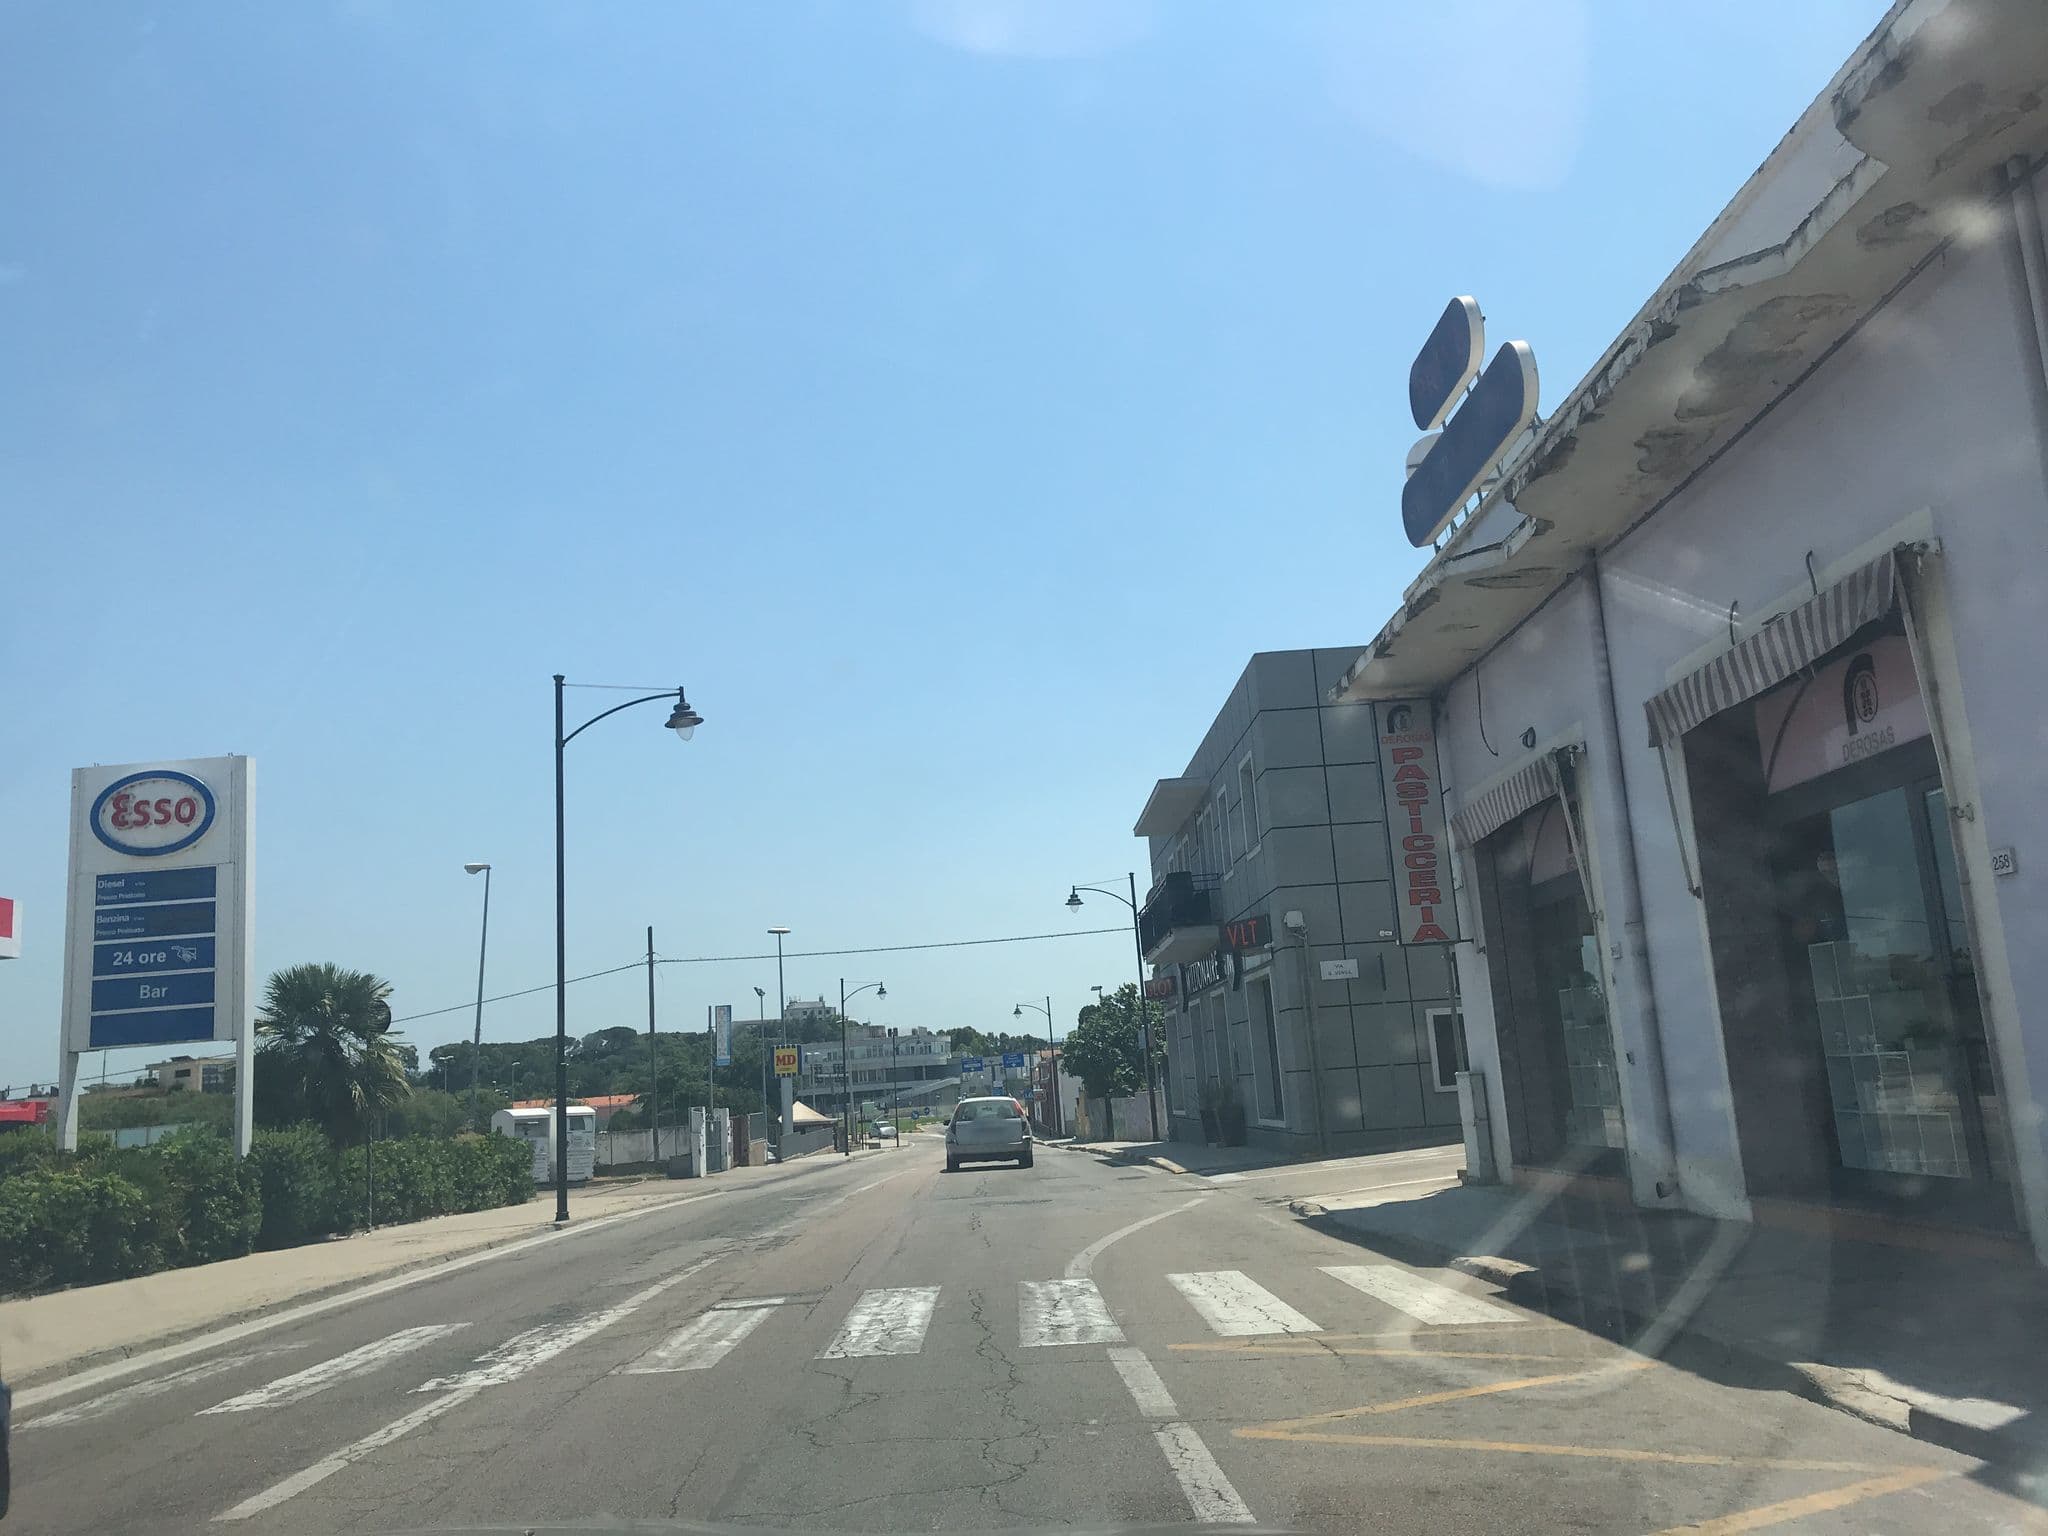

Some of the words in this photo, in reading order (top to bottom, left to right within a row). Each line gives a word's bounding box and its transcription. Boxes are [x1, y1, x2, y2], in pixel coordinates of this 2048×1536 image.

[1842, 726, 1896, 761] DEROSAS
[1392, 746, 1450, 942] PASTICCERIA
[1992, 854, 2010, 871] 258
[97, 879, 125, 889] Diesel
[96, 914, 130, 924] Benzina
[1227, 920, 1257, 949] VLT
[112, 950, 133, 966] 24
[138, 950, 167, 964] ore
[139, 984, 169, 999] Bar
[776, 1054, 797, 1068] MD
